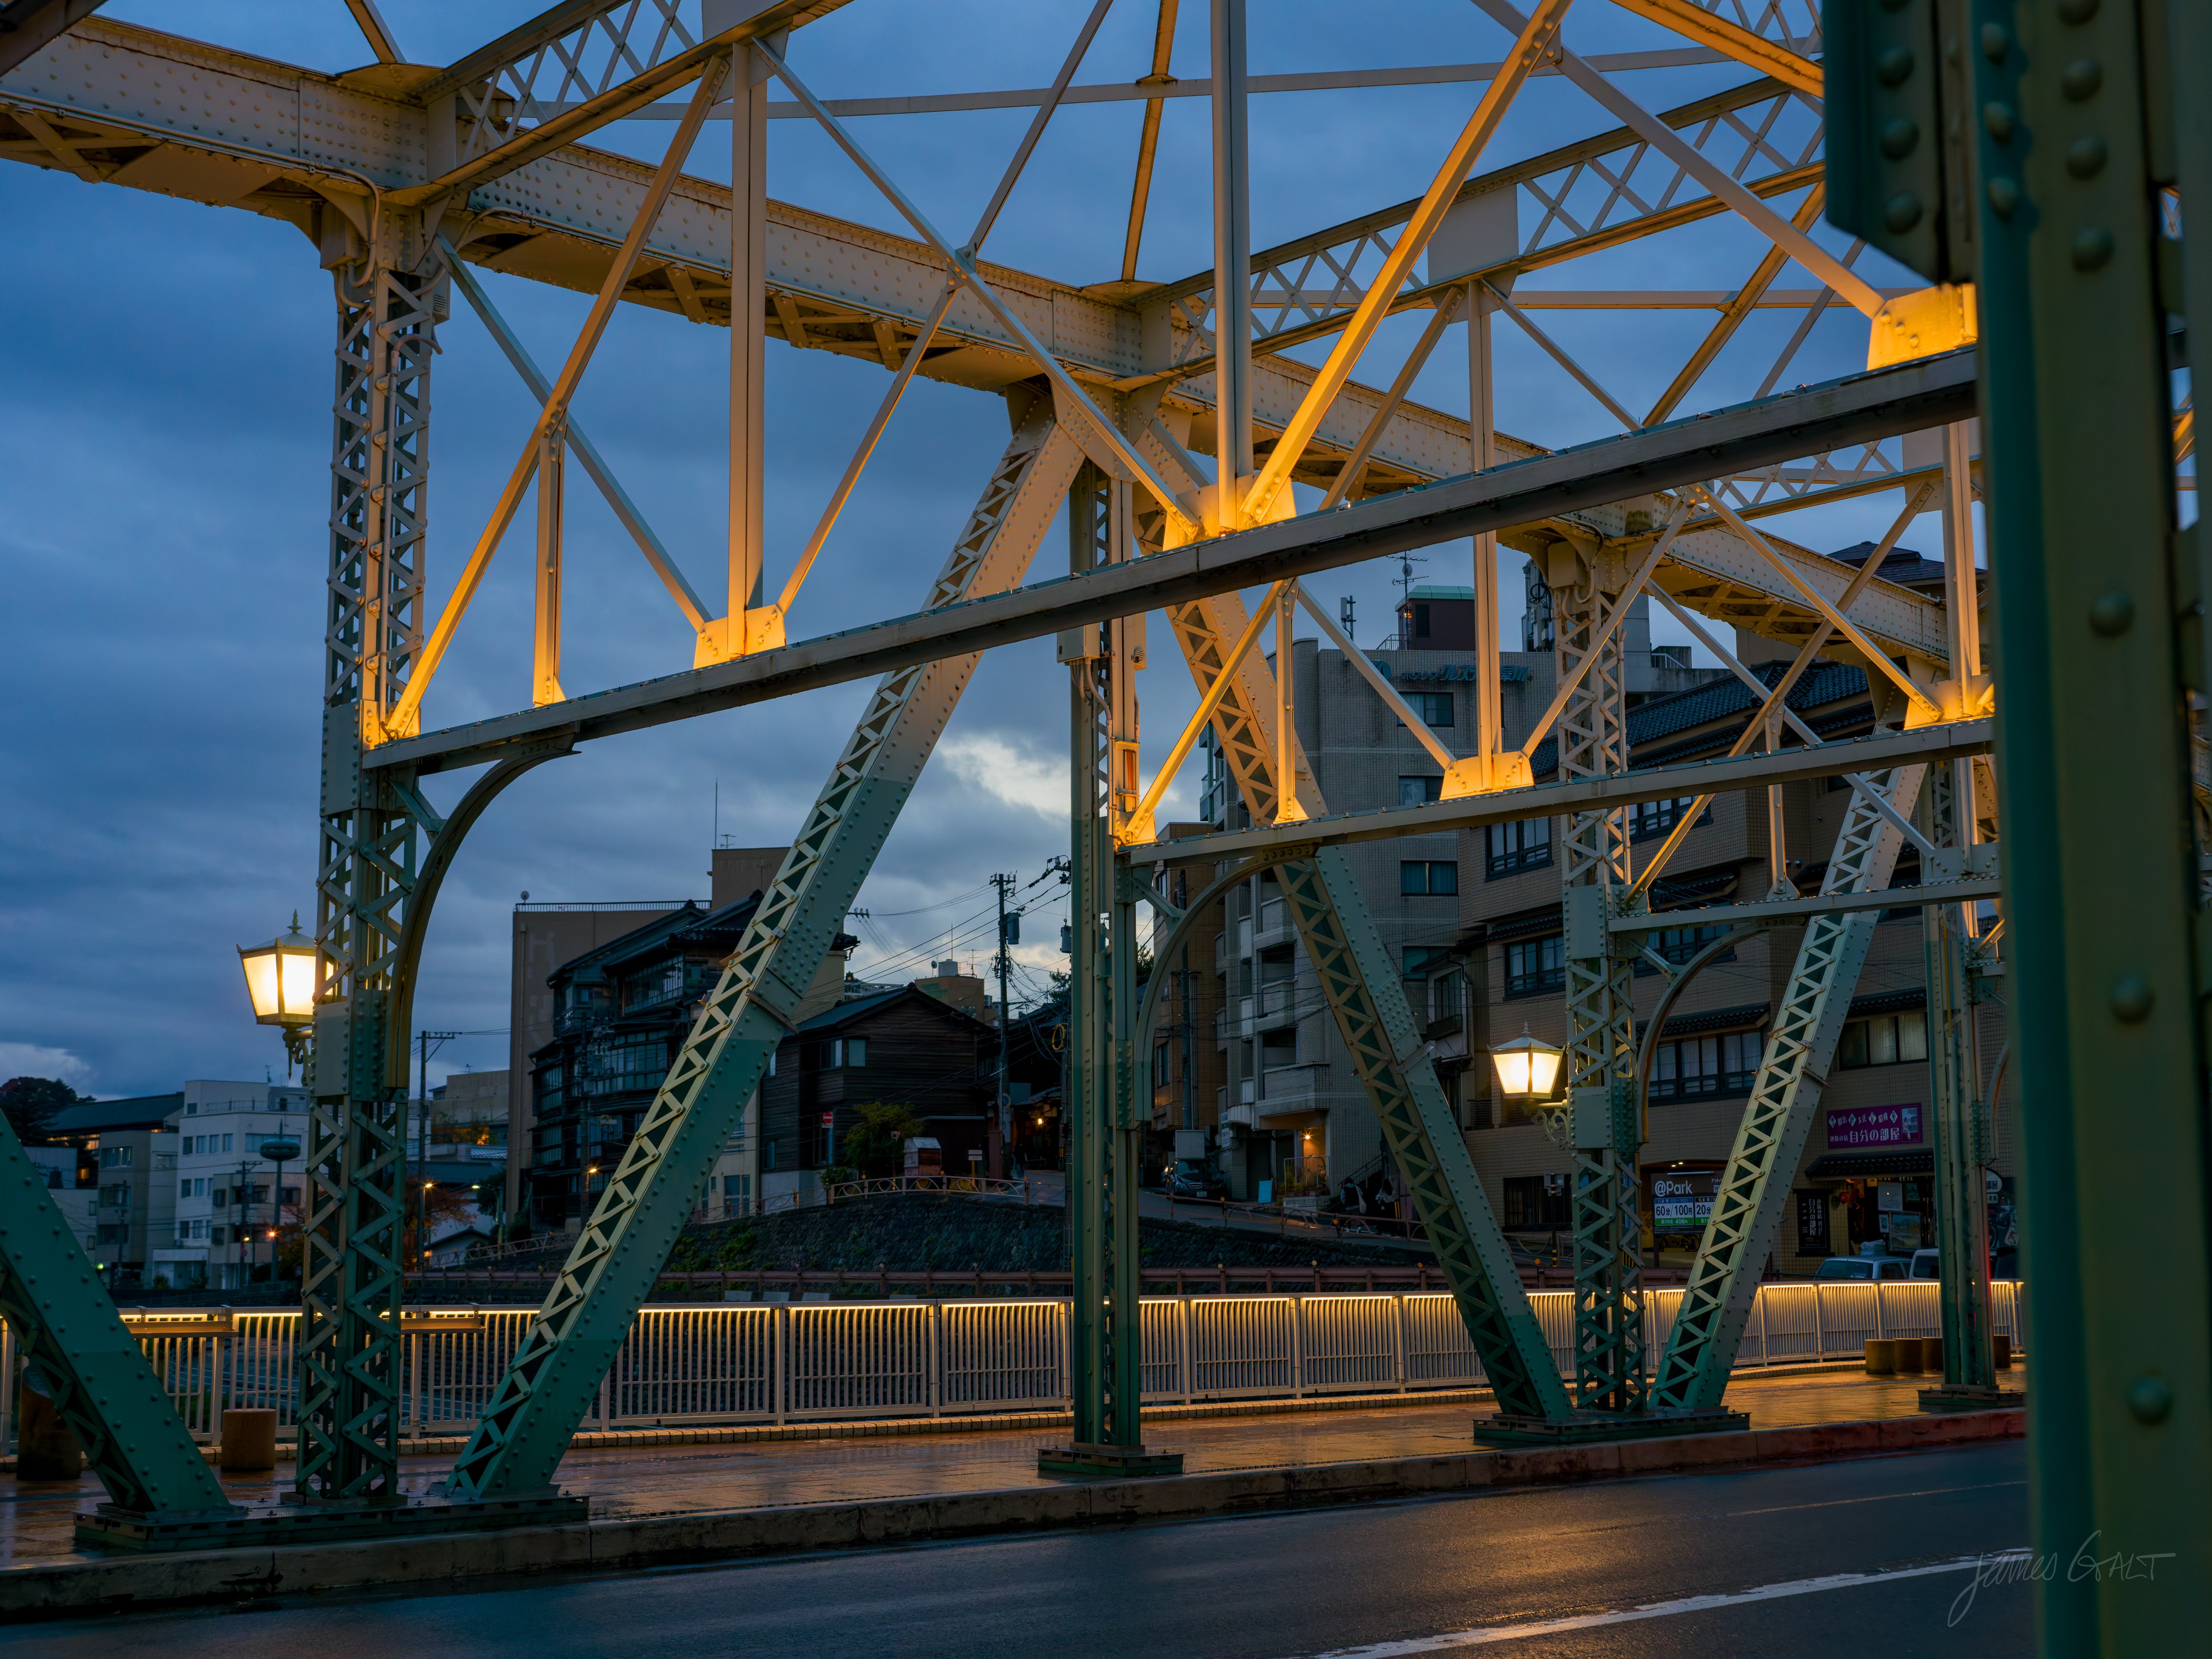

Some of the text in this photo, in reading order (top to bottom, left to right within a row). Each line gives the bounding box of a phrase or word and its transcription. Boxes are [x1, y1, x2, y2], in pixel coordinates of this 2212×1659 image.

[1837, 1112, 1888, 1126] 明治 大正 昭和
[1849, 1127, 1900, 1143] 自分の部屋
[1655, 1180, 1693, 1197] @Park
